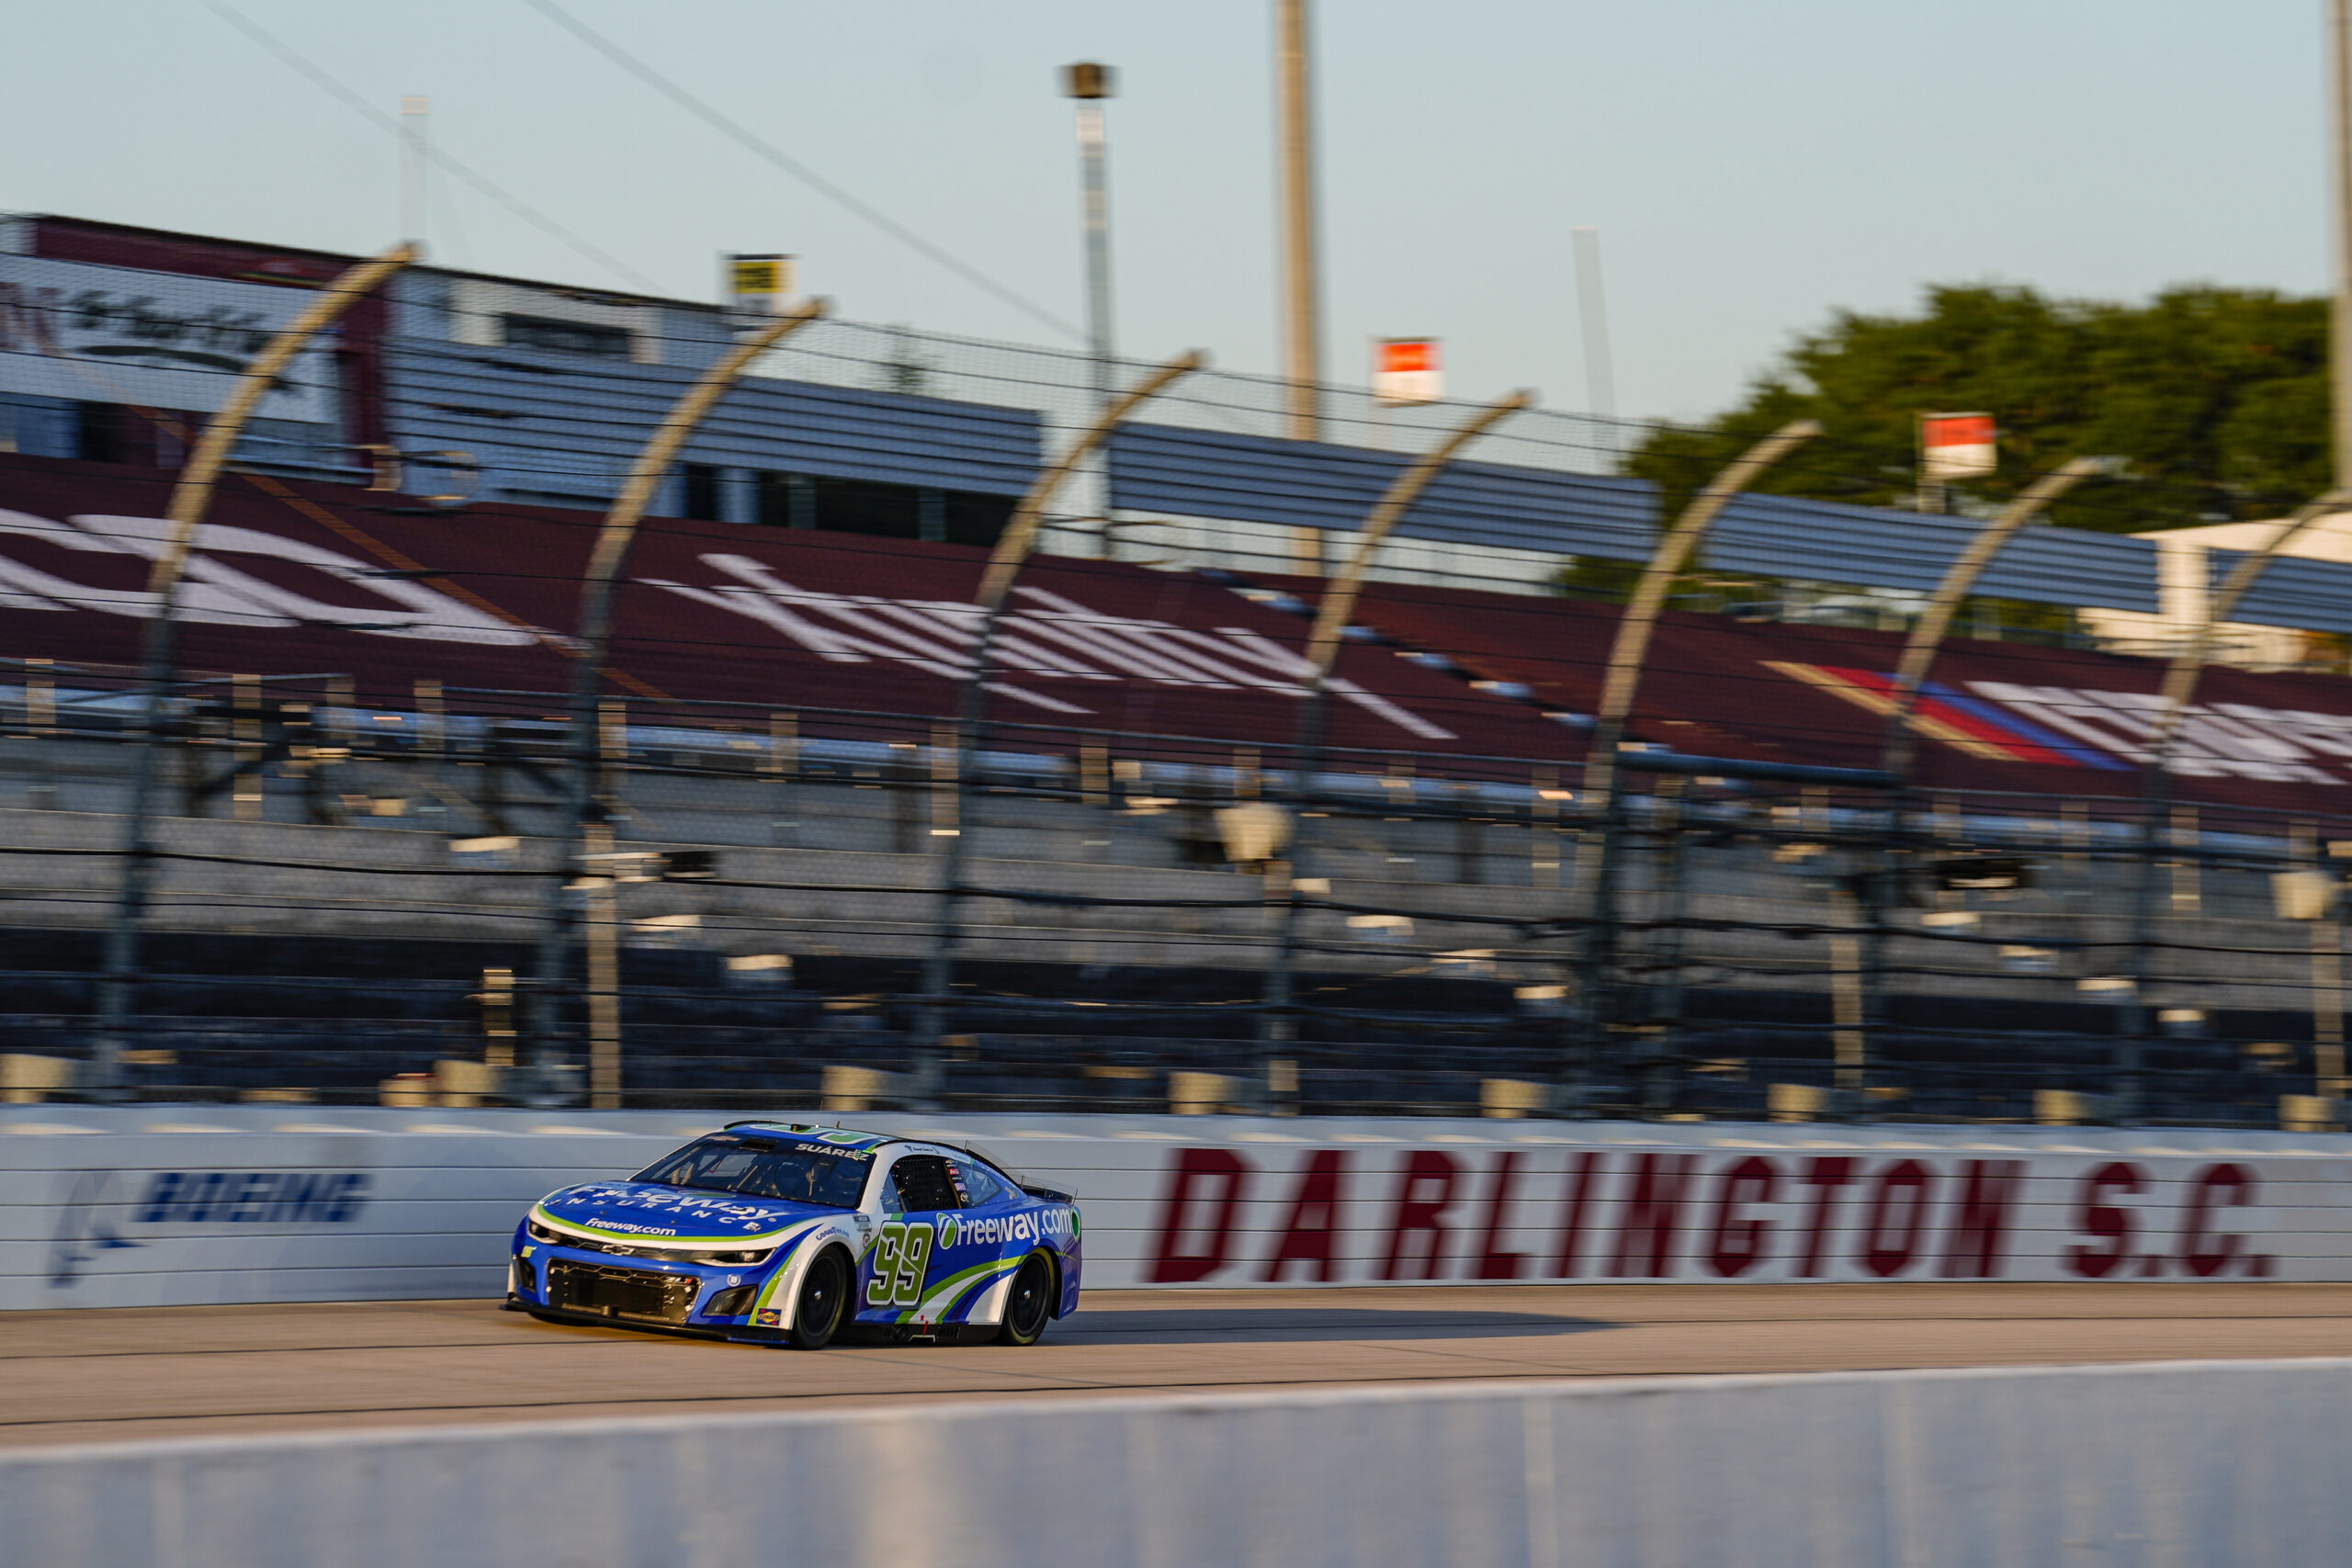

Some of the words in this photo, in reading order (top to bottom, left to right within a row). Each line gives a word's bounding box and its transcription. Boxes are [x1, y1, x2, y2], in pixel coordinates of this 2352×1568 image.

[133, 1172, 376, 1224] BOEING
[1142, 1147, 2029, 1282] DARLINGTON
[2056, 1161, 2282, 1278] S.C.
[584, 1217, 677, 1236] Freeway.com
[952, 1207, 1073, 1246] Freeway.com
[866, 1221, 935, 1306] 99
